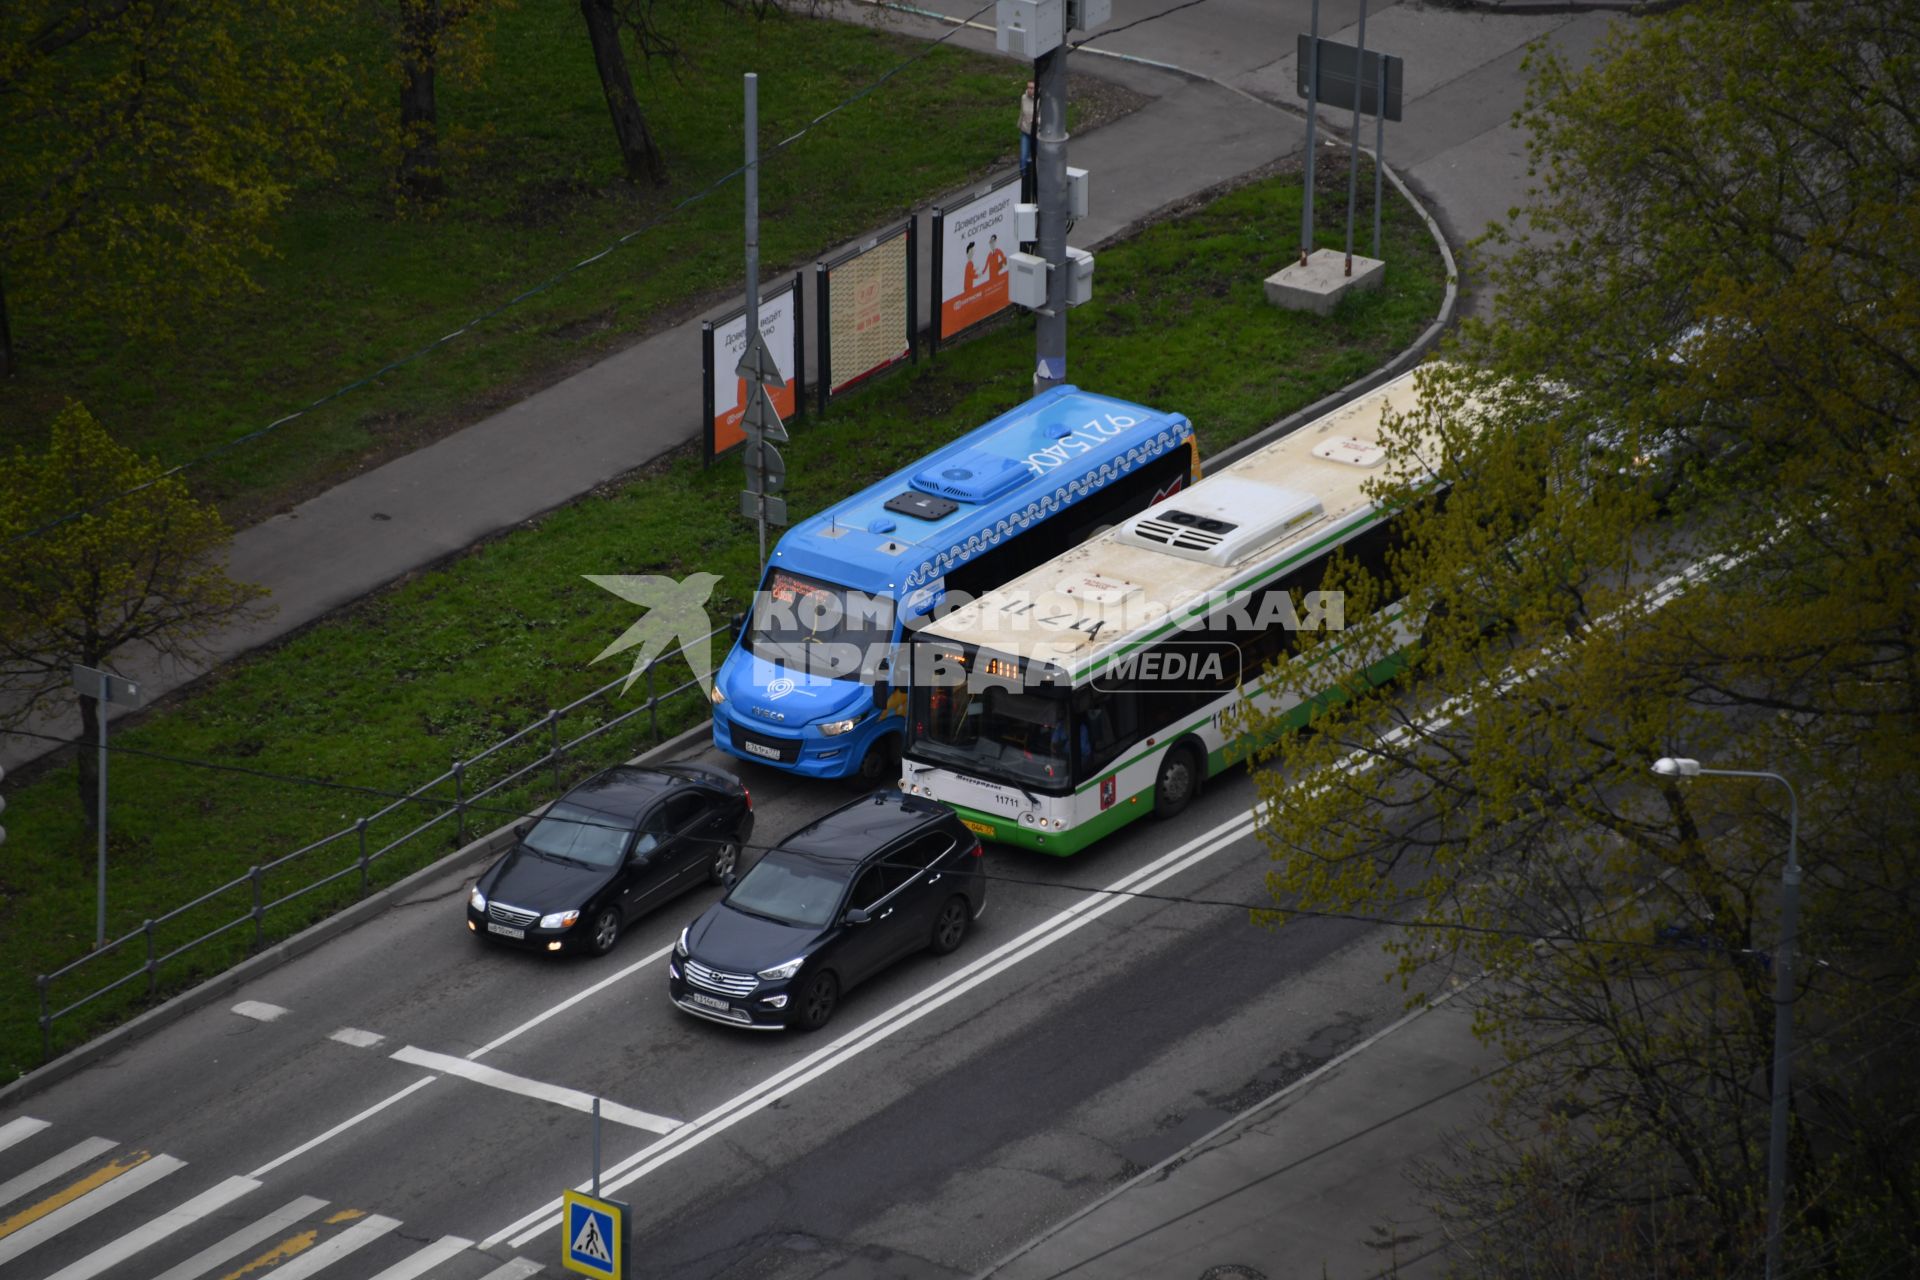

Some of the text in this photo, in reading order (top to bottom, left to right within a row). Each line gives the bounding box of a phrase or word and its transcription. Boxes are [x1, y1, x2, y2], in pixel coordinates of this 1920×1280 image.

[954, 210, 987, 233] Доверие
[967, 214, 1004, 238] согласию
[751, 705, 785, 721] IVECO
[995, 794, 1019, 808] 11711
